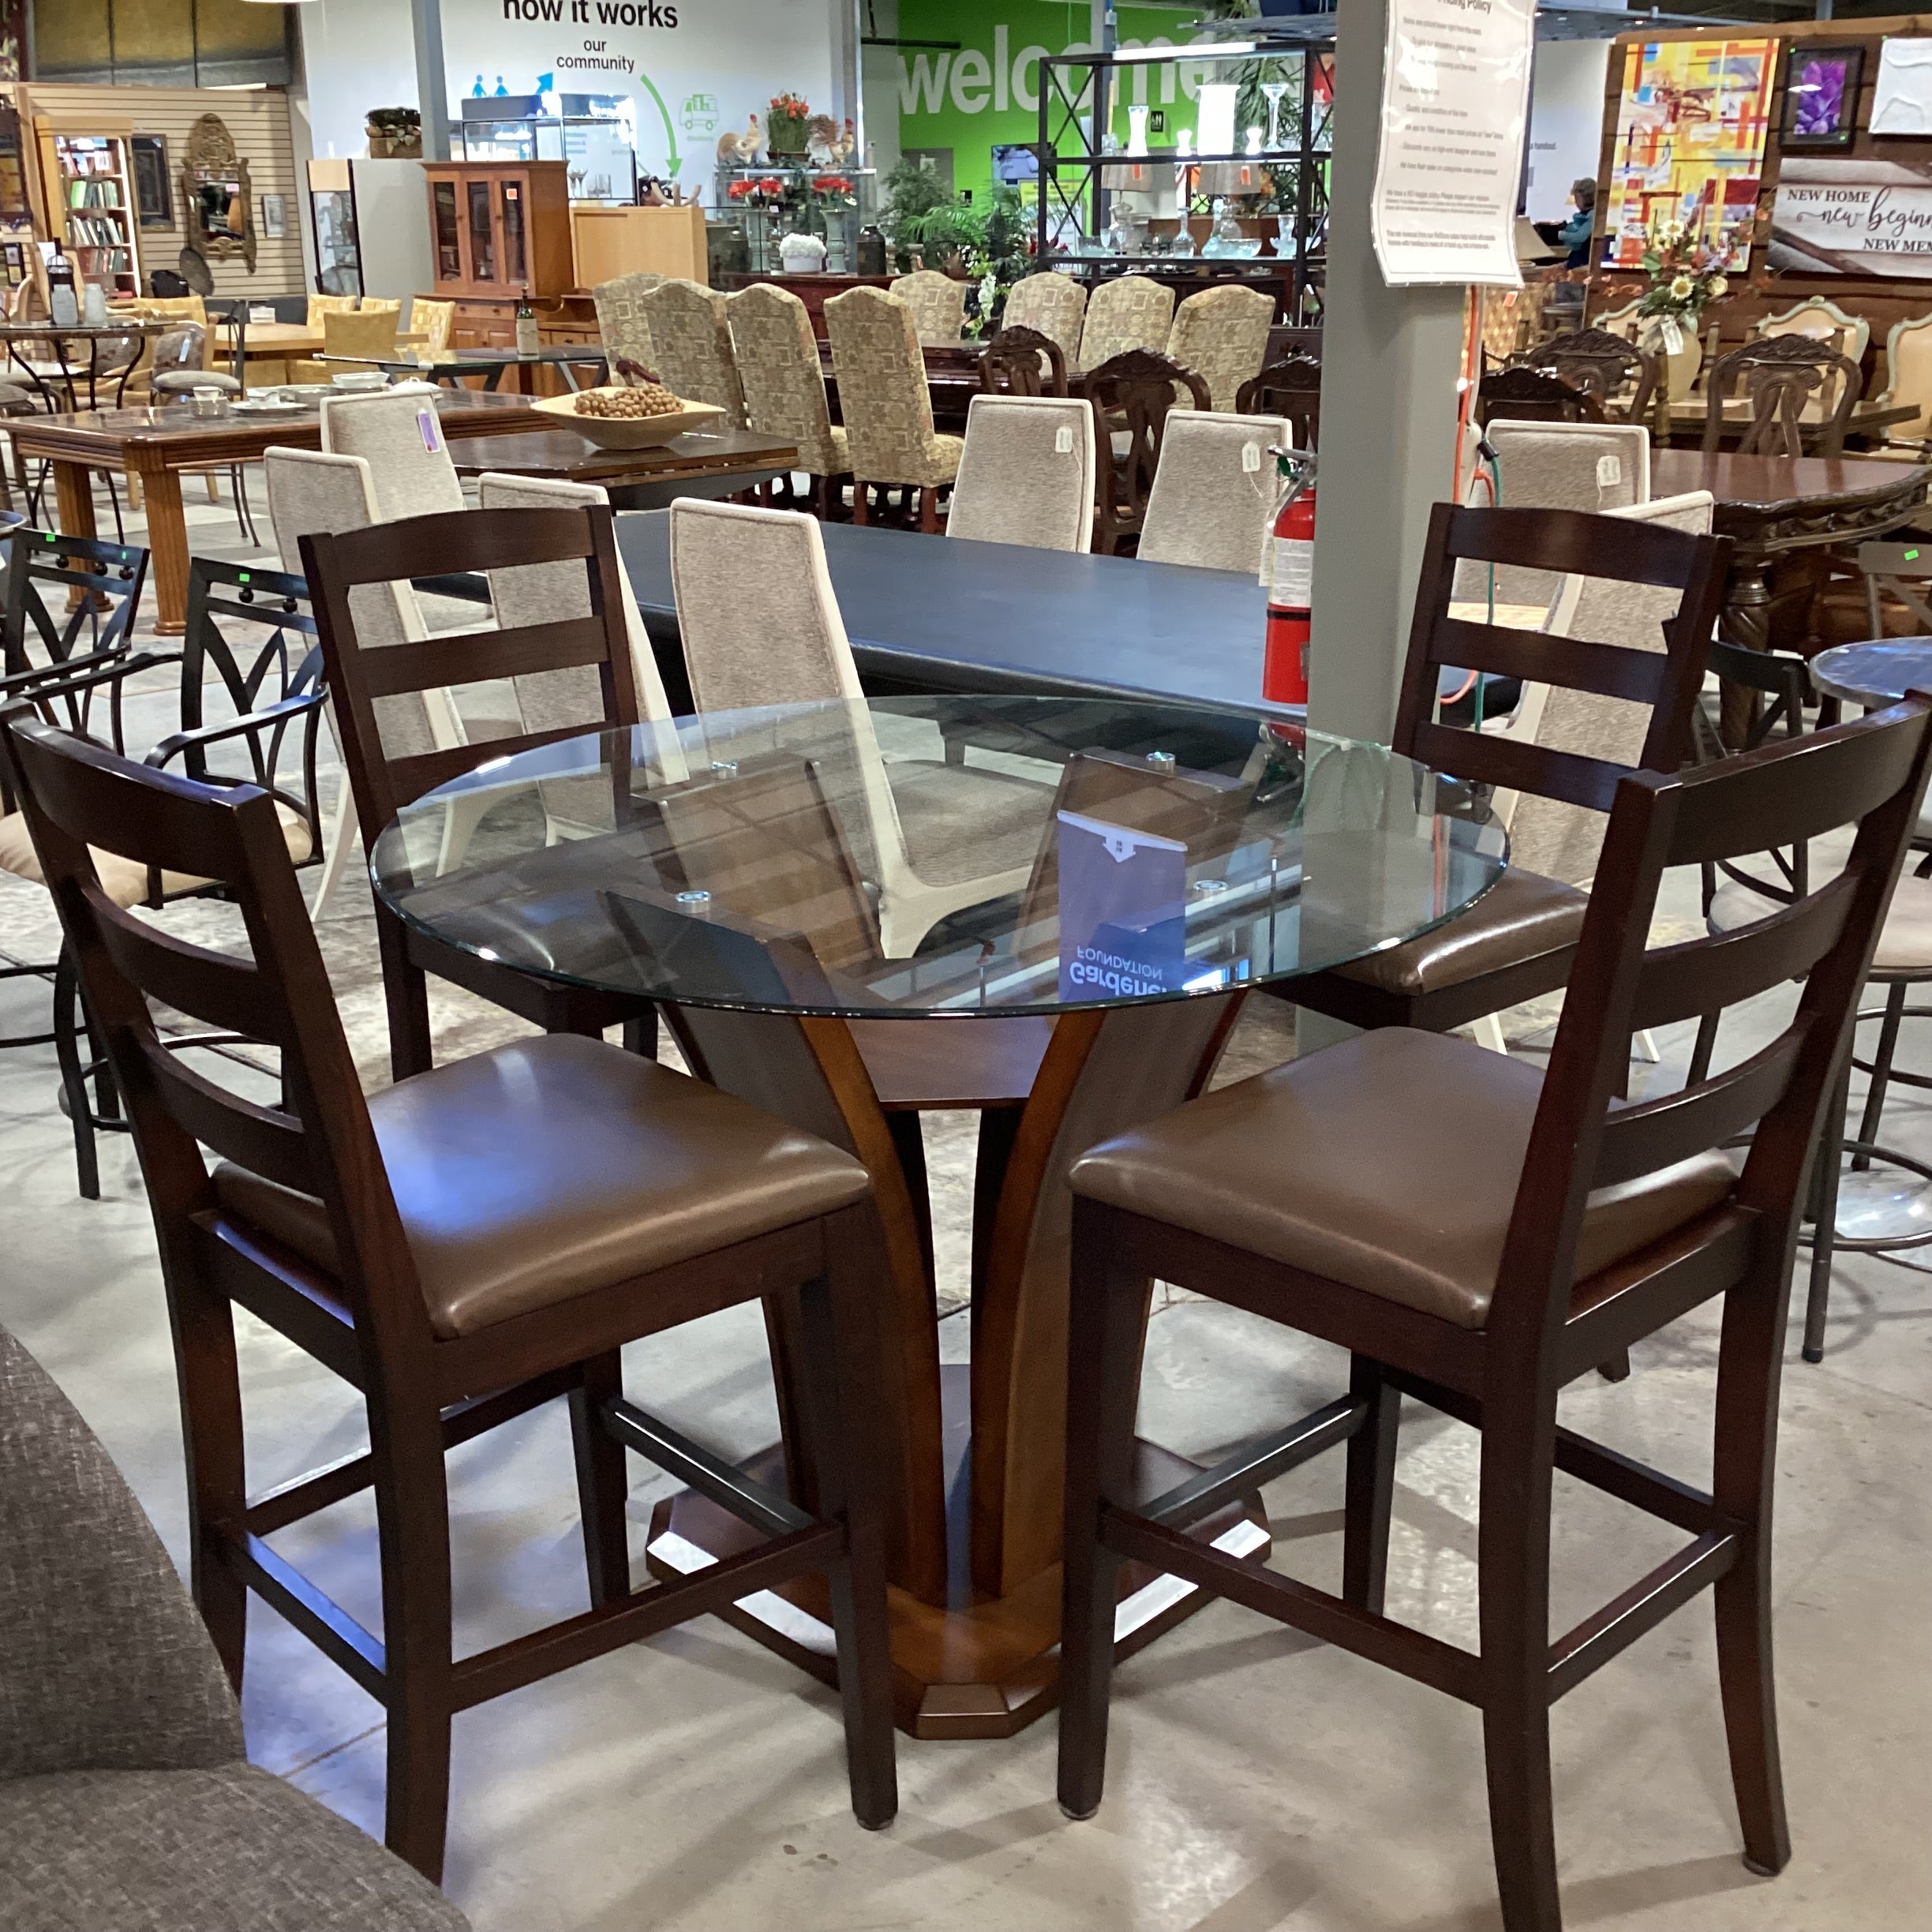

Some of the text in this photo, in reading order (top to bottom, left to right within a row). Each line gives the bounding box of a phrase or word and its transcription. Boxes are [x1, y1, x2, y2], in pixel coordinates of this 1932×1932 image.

[571, 0, 590, 23] it
[597, 0, 678, 28] works
[583, 39, 607, 52] our
[556, 54, 635, 73] community
[1788, 189, 1871, 203] NEW HOME
[1863, 238, 1900, 251] NEW
